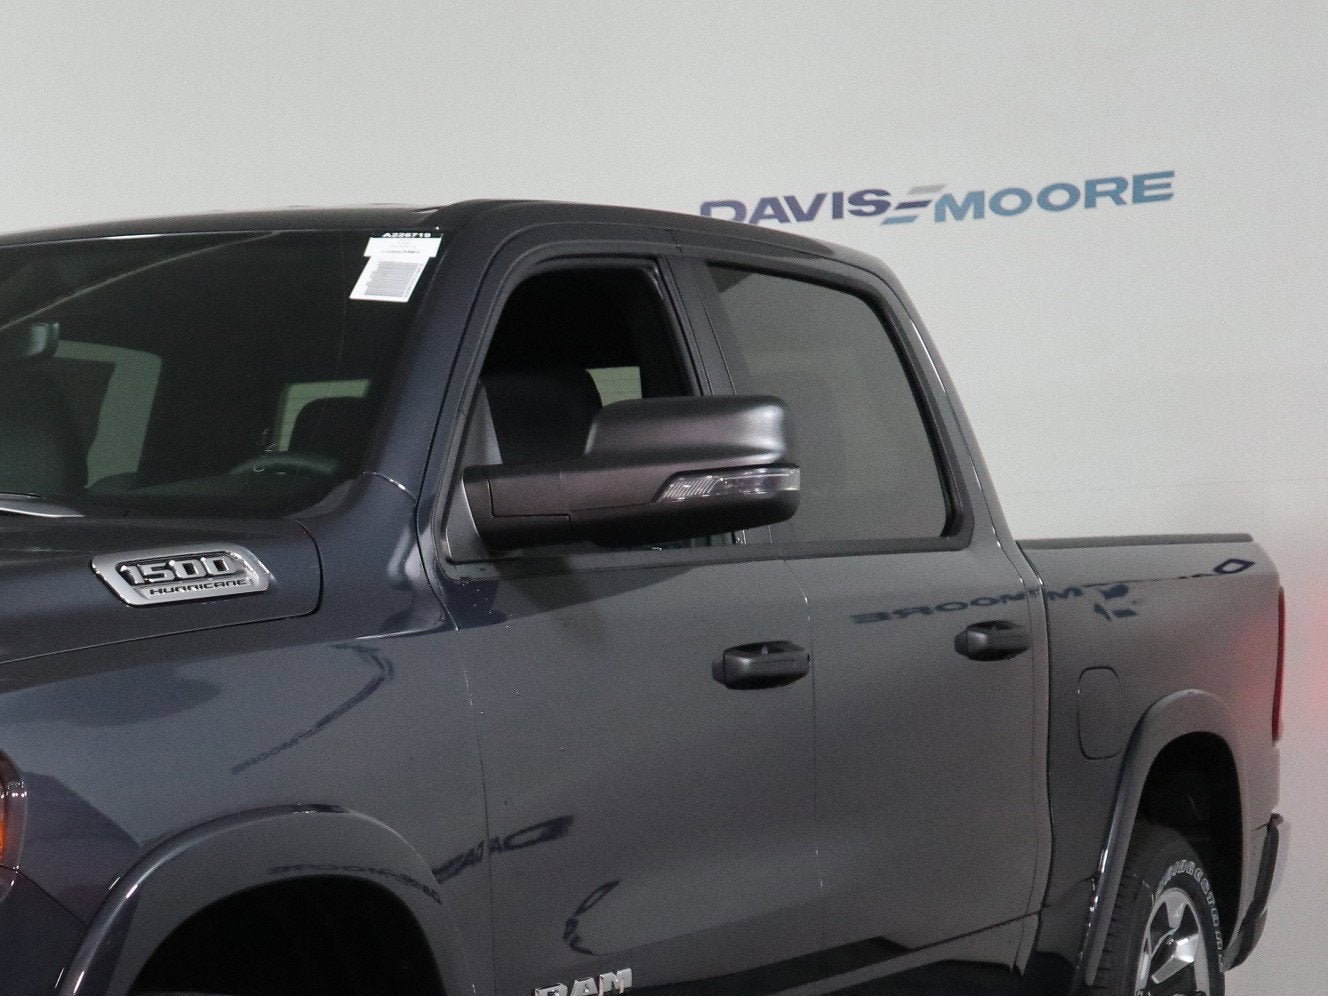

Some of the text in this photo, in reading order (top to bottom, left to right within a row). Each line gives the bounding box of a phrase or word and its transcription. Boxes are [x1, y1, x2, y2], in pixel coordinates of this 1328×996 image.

[700, 170, 1175, 225] DAVIS MOORE
[120, 554, 245, 586] 1500
[149, 579, 248, 595] HURRICANE
